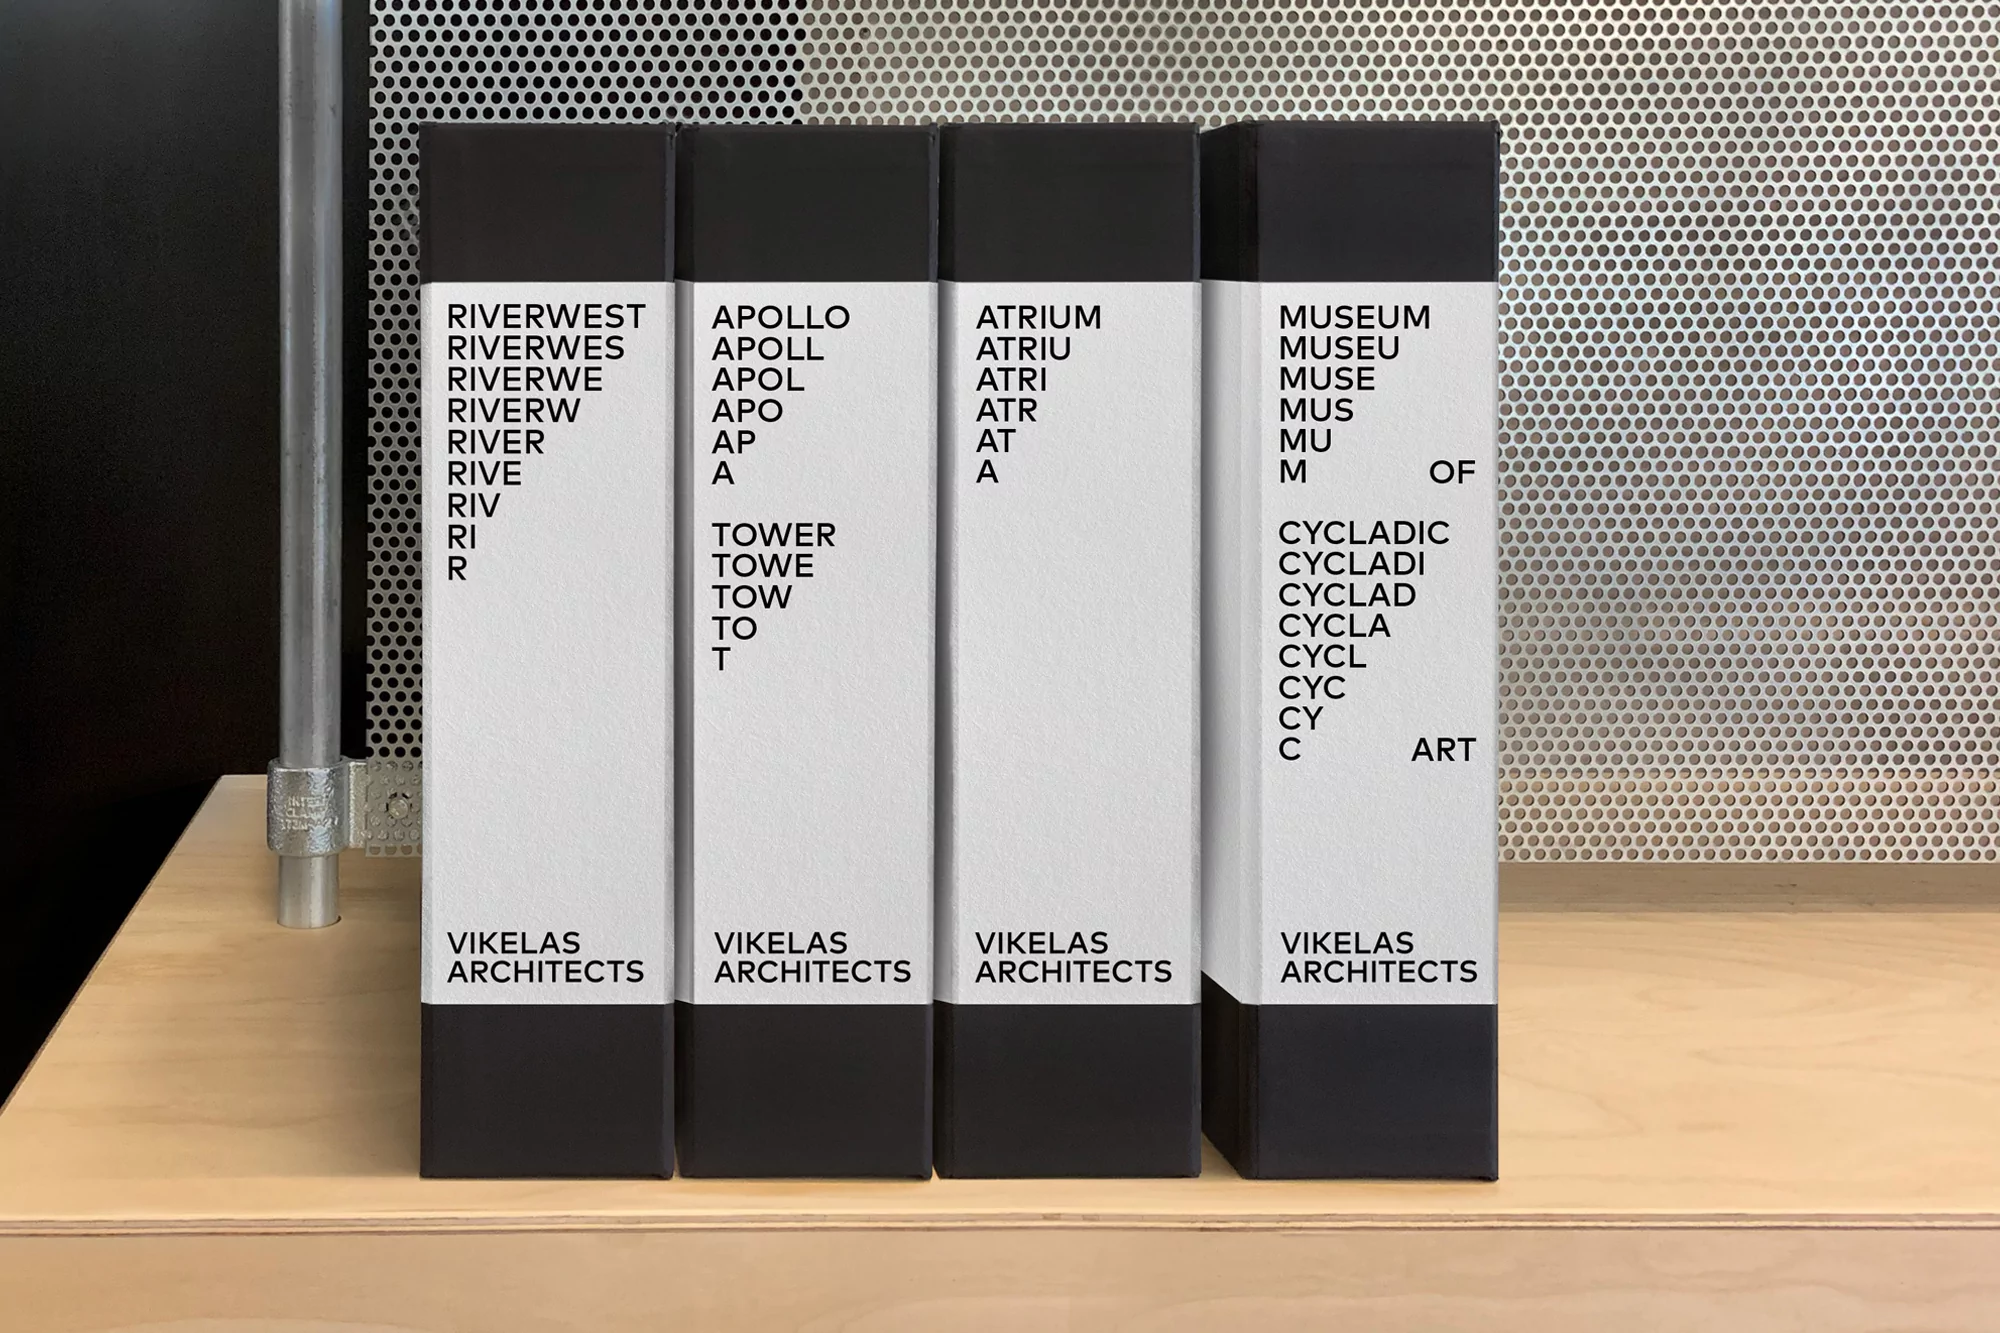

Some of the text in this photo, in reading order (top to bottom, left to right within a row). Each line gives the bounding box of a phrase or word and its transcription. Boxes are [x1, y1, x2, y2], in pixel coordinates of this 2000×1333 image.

[448, 303, 647, 329] RIVERWEST
[711, 305, 850, 330] APOLLO
[975, 305, 1101, 330] ATRIUM
[1280, 304, 1430, 330] MUSEUM
[448, 334, 625, 360] RIVERWES
[711, 336, 825, 361] APOLL
[975, 336, 1071, 361] ATRIU
[1280, 335, 1399, 360] MUSEU
[448, 366, 603, 392] RIVERWE
[711, 367, 805, 392] APOL
[975, 367, 1046, 392] ATRI
[1280, 366, 1375, 391] MUSE
[448, 397, 581, 423] RIVERW
[711, 398, 783, 423] APO
[975, 397, 1038, 422] ATR
[1280, 397, 1354, 422] MUS
[448, 429, 545, 455] RIVER
[711, 429, 756, 454] AP
[975, 428, 1017, 453] AT
[1280, 428, 1332, 453] MU
[448, 460, 522, 486] RIVE
[711, 460, 735, 485] A
[975, 459, 999, 484] A
[1280, 459, 1476, 484] M OF
[448, 492, 501, 518] RIV
[448, 524, 476, 550] RI
[711, 522, 836, 547] TOWER
[1278, 520, 1450, 545] CYCLADIC
[448, 555, 468, 581] R
[711, 553, 814, 578] TOWE
[1278, 551, 1425, 576] CYCLADI
[711, 584, 793, 609] TOW
[1278, 582, 1416, 607] CYCLAD
[711, 615, 758, 641] TO
[1278, 613, 1391, 638] CYCLA
[711, 646, 731, 671] T
[1278, 643, 1367, 669] CYCL
[1278, 675, 1346, 700] CYC
[1278, 705, 1324, 731] CY
[1278, 736, 1477, 762] C ART
[446, 931, 581, 955] VIKELAS
[714, 931, 848, 955] VIKELAS
[974, 931, 1109, 955] VIKELAS
[1280, 931, 1414, 955] VIKELAS
[446, 959, 645, 984] ARCHITECTS
[714, 959, 912, 984] ARCHITECTS
[975, 959, 1173, 984] ARCHITECTS
[1280, 959, 1478, 984] ARCHITECTS
